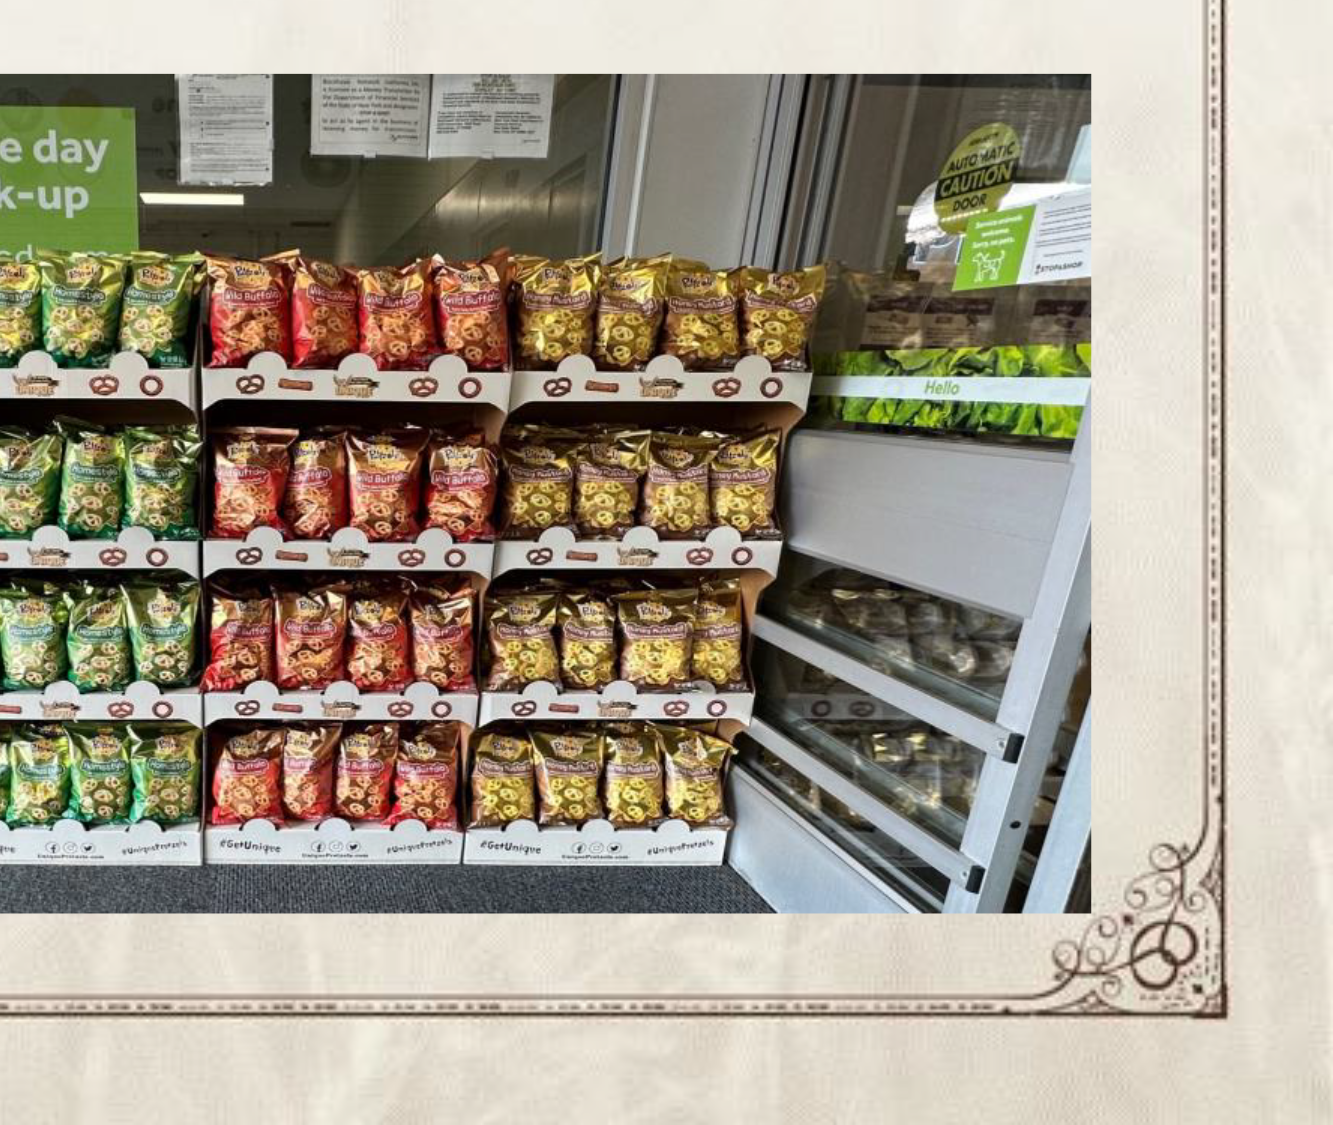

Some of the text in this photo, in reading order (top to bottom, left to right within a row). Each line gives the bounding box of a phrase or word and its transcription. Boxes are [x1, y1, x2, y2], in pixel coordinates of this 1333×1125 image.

[33, 129, 109, 174] day
[946, 141, 1016, 174] AUTOMATIC
[940, 160, 1015, 198] CAUTION
[952, 193, 988, 213] DOOR
[53, 287, 105, 302] Homestyle
[126, 288, 176, 301] Homestyle
[225, 290, 280, 303] Wild Buffalo
[443, 291, 501, 306] Wild Buffalo
[924, 380, 961, 397] Hello
[433, 472, 487, 486] Wild Buffalo
[219, 838, 282, 855] #GetUnique
[479, 839, 542, 856] #GetUnique
